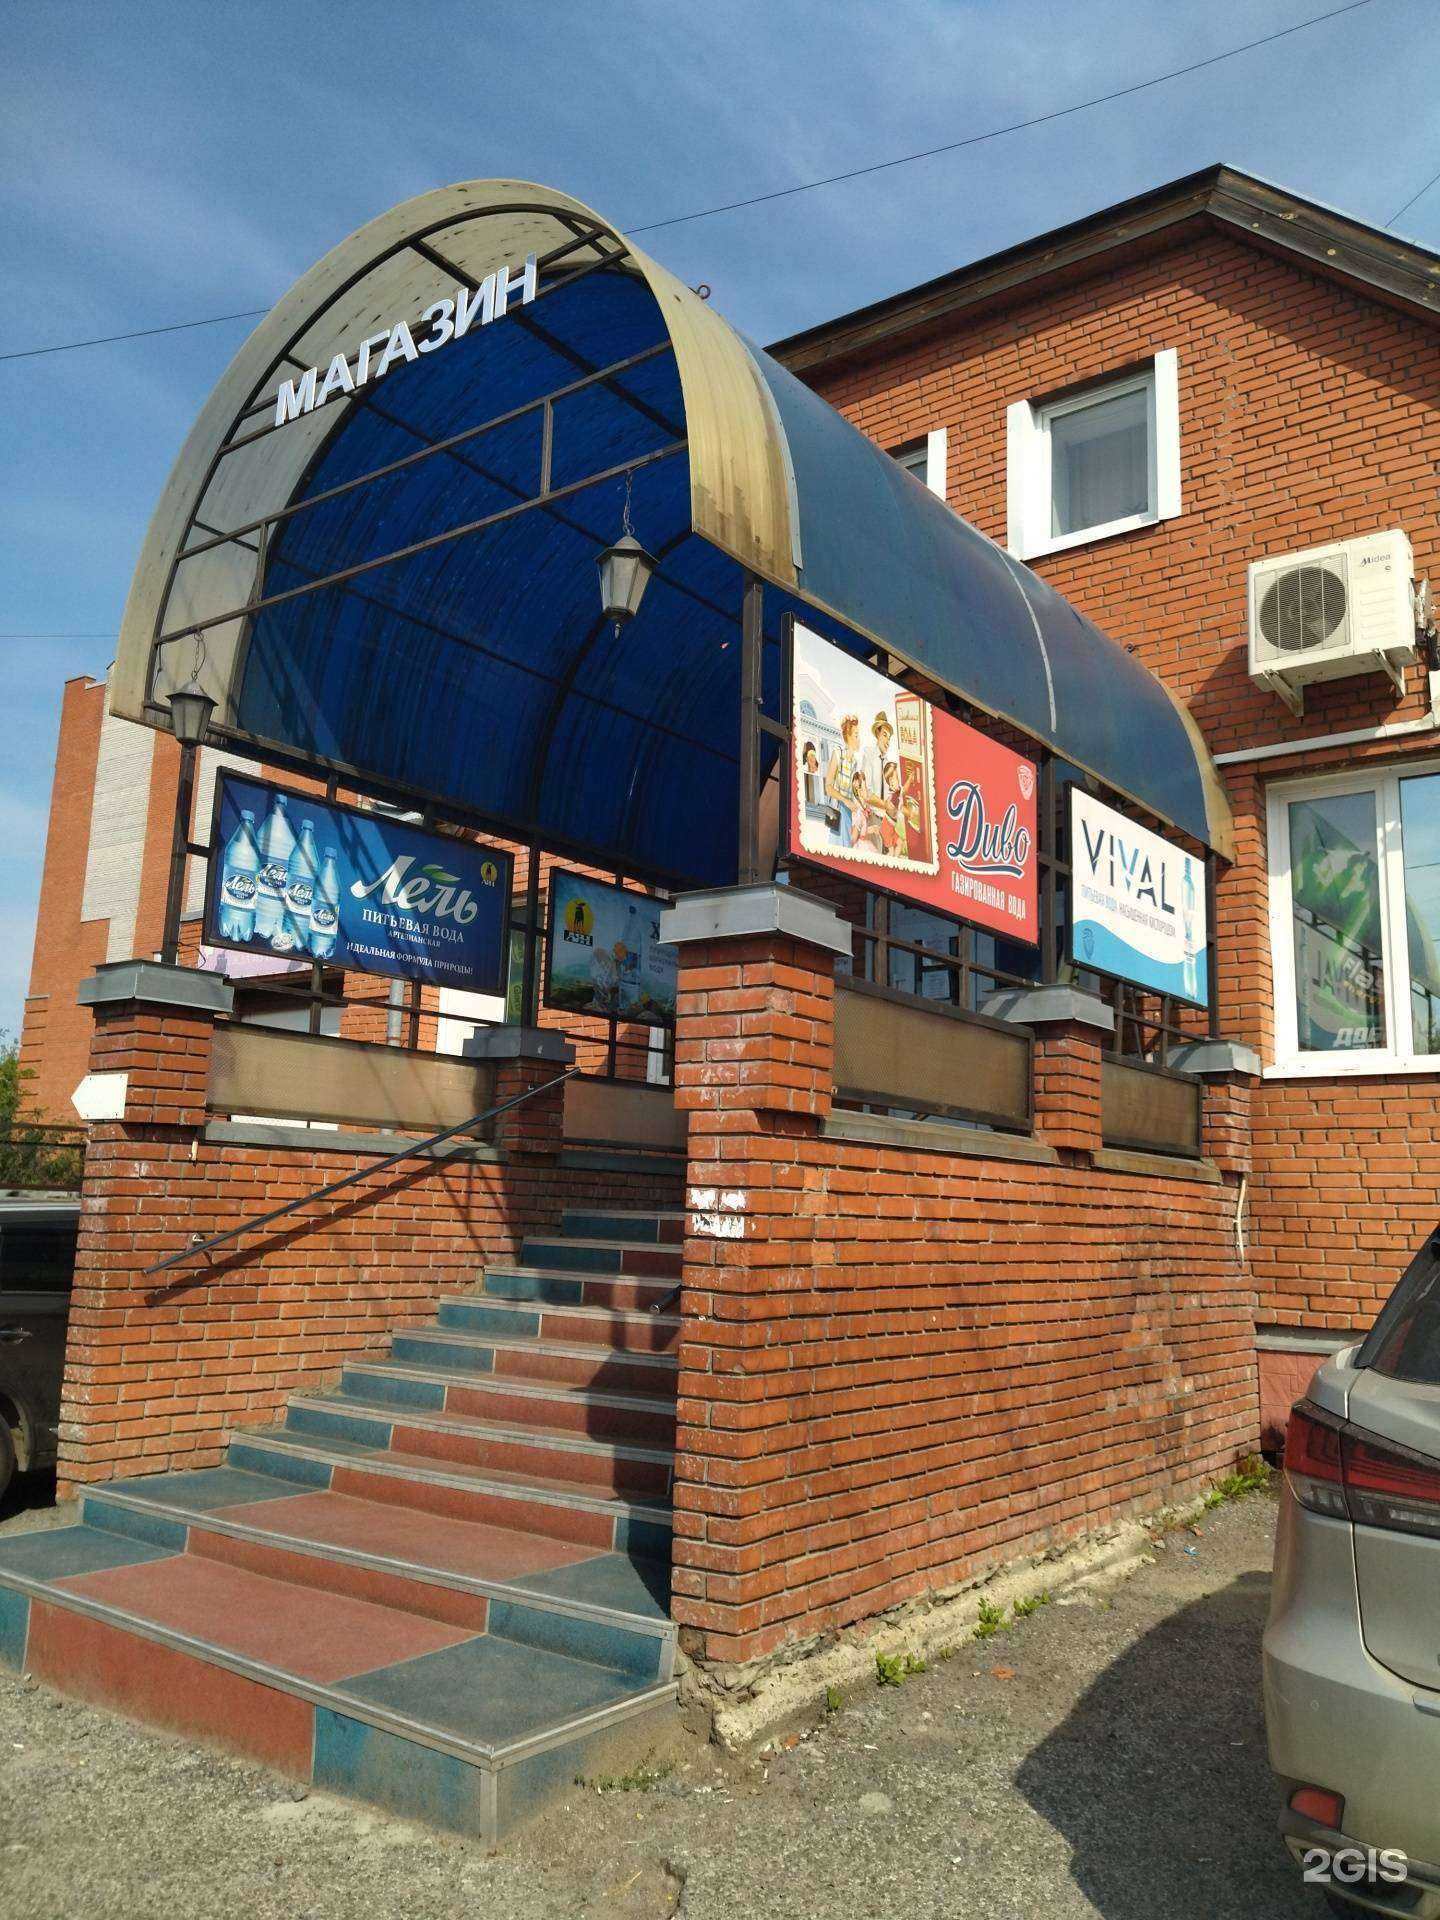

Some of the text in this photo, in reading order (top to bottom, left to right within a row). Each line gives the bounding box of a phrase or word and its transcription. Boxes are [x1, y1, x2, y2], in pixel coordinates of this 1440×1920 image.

[275, 251, 538, 427] МАГАЗИН
[1361, 553, 1391, 566] Midea
[946, 780, 1031, 866] Диво
[351, 855, 478, 924] Лель
[951, 870, 1027, 921] ГАЗИРОВАННАЯ ВОДА
[362, 908, 465, 943] ПИТЬЕВАЯ ВОДА
[388, 930, 441, 948] АРТЕЗИАНСКАЯ
[346, 942, 396, 960] ИДЕАЛЬНАЯ
[396, 953, 433, 967] ФОРМУЛА
